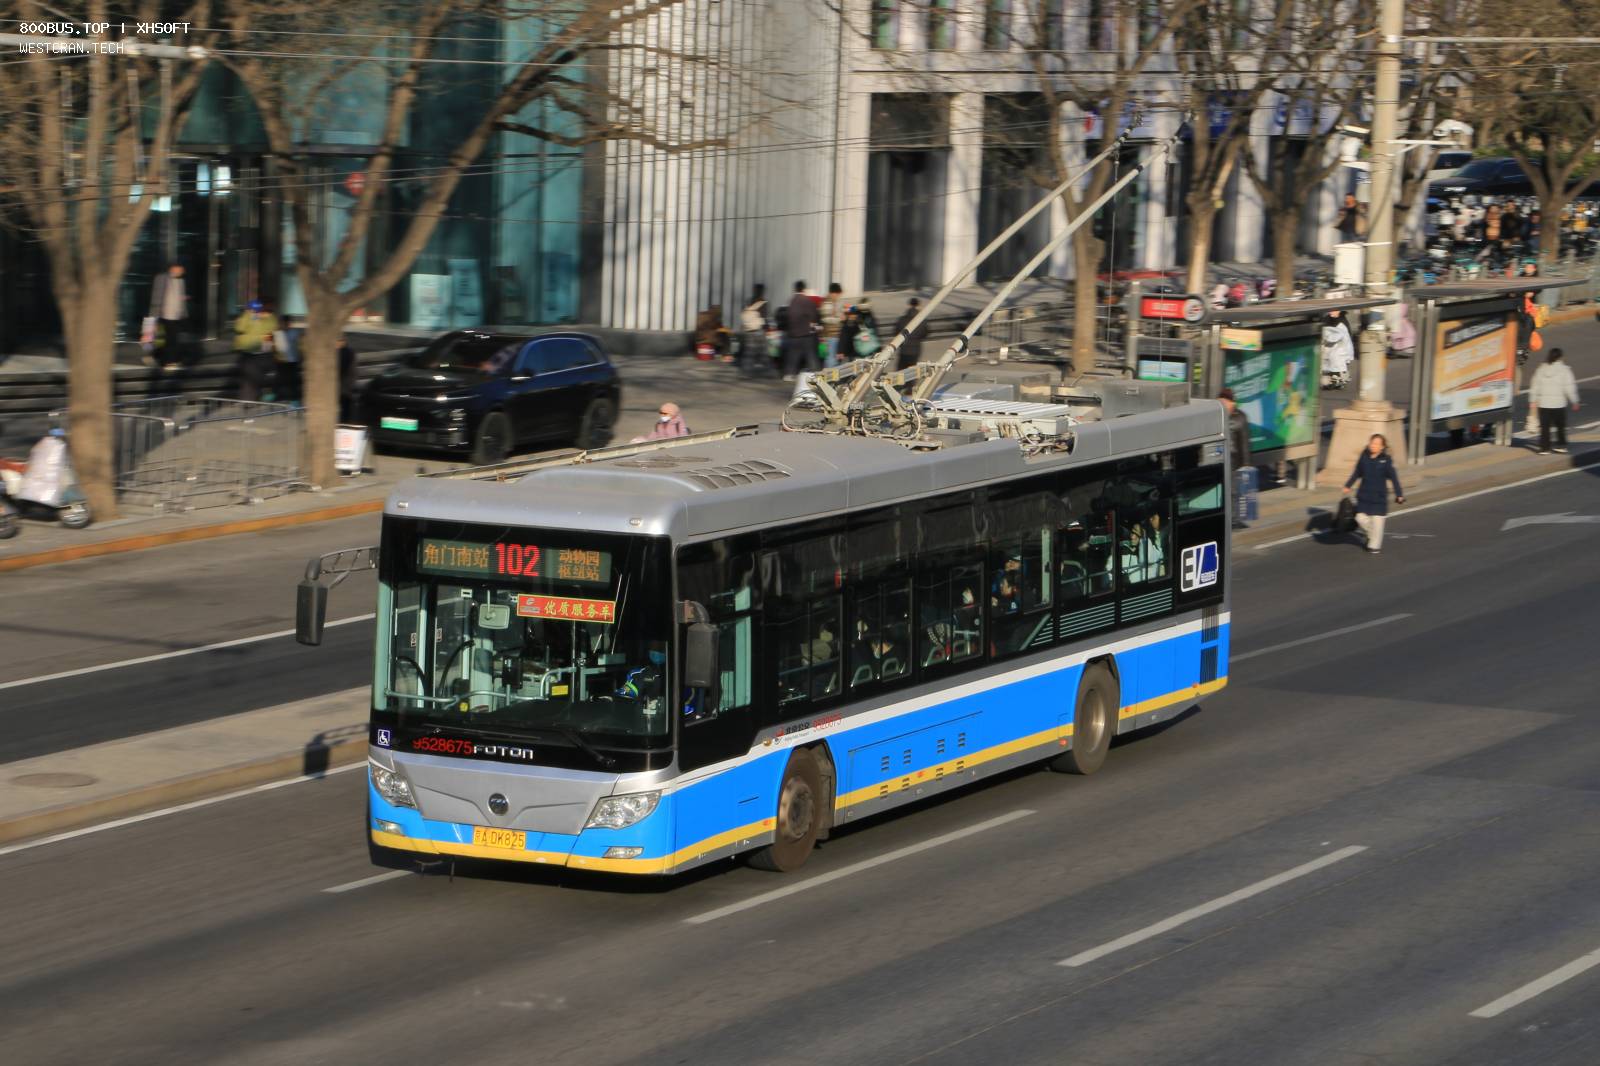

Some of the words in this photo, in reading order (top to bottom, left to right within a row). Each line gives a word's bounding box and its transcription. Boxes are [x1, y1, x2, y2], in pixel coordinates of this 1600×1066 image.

[424, 544, 489, 569] 角门南站
[495, 543, 541, 577] 102
[558, 549, 600, 567] 动物园
[558, 564, 600, 582] 枢纽站
[544, 600, 611, 620] 优质服务车
[413, 737, 473, 755] 9528675
[473, 744, 534, 759] FOTON
